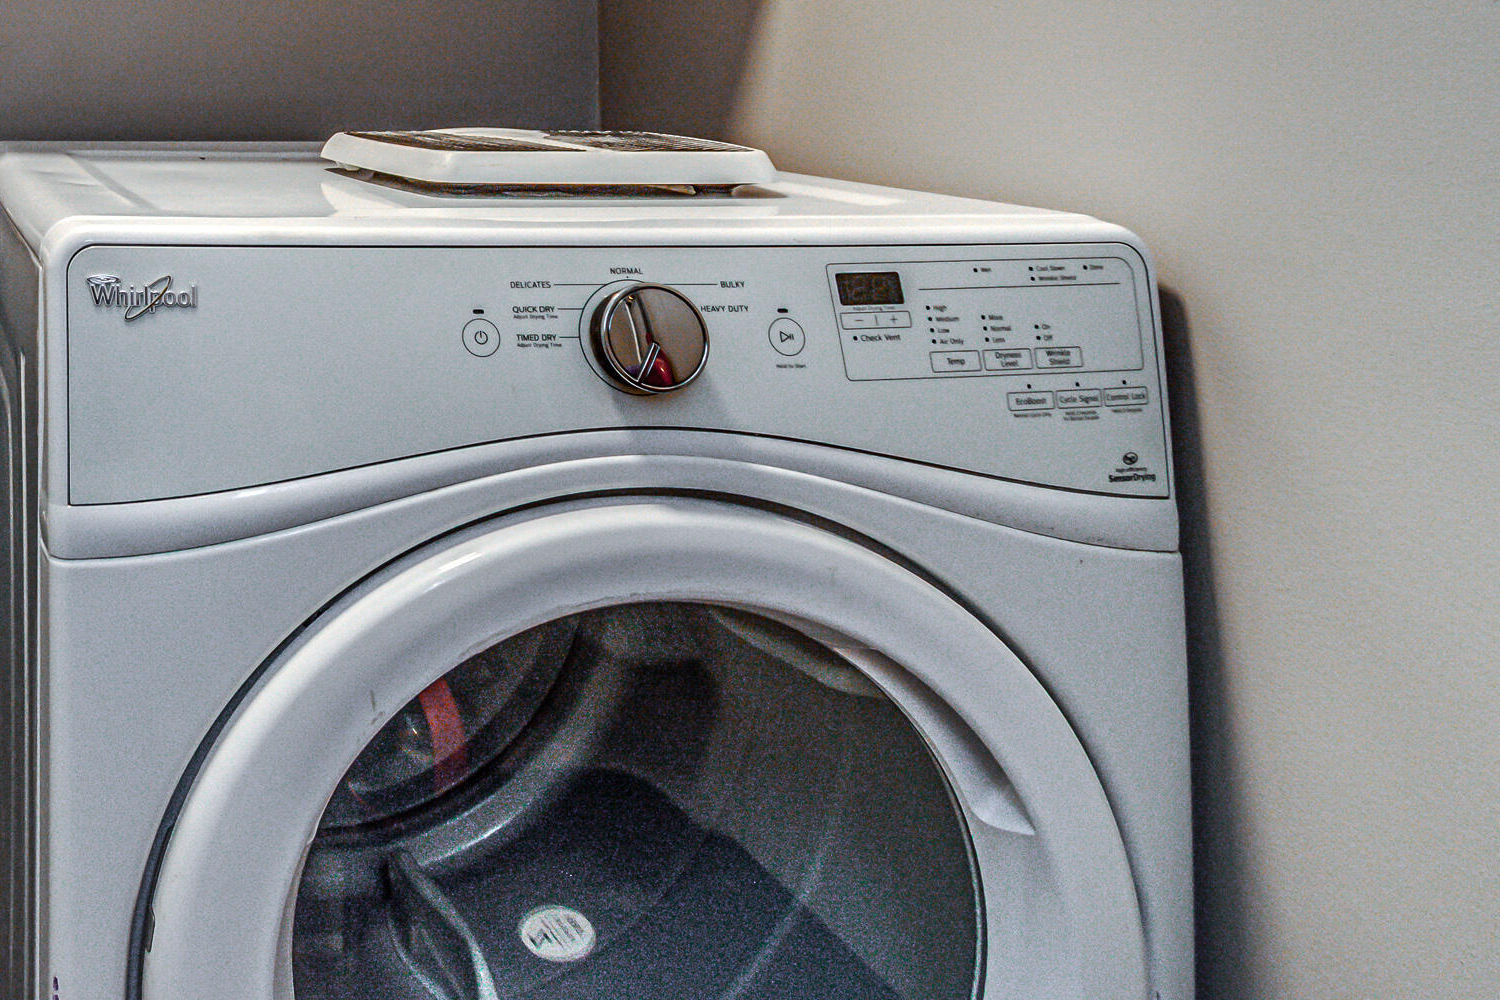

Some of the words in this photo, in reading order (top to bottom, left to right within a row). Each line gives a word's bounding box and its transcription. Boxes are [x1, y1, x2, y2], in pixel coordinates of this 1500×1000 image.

[609, 267, 643, 275] NORMAL
[510, 281, 552, 289] DELICATES
[720, 280, 745, 288] BULKY
[86, 274, 198, 322] Whirlpool
[512, 305, 538, 313] QUICK
[539, 305, 556, 313] DRY
[700, 304, 726, 312] HEAVY
[727, 304, 749, 312] DUTY
[516, 333, 539, 342] TIMED
[541, 333, 557, 342] DRY
[860, 334, 883, 342] Check
[994, 351, 1022, 360] Dryness
[946, 356, 966, 366] Temp
[1000, 359, 1019, 367] Level
[1049, 358, 1070, 366] Shield
[1078, 395, 1099, 404] Signal
[1131, 392, 1146, 400] Lock
[1015, 397, 1047, 405] EcoBoost
[1108, 473, 1156, 483] SensorDrying
